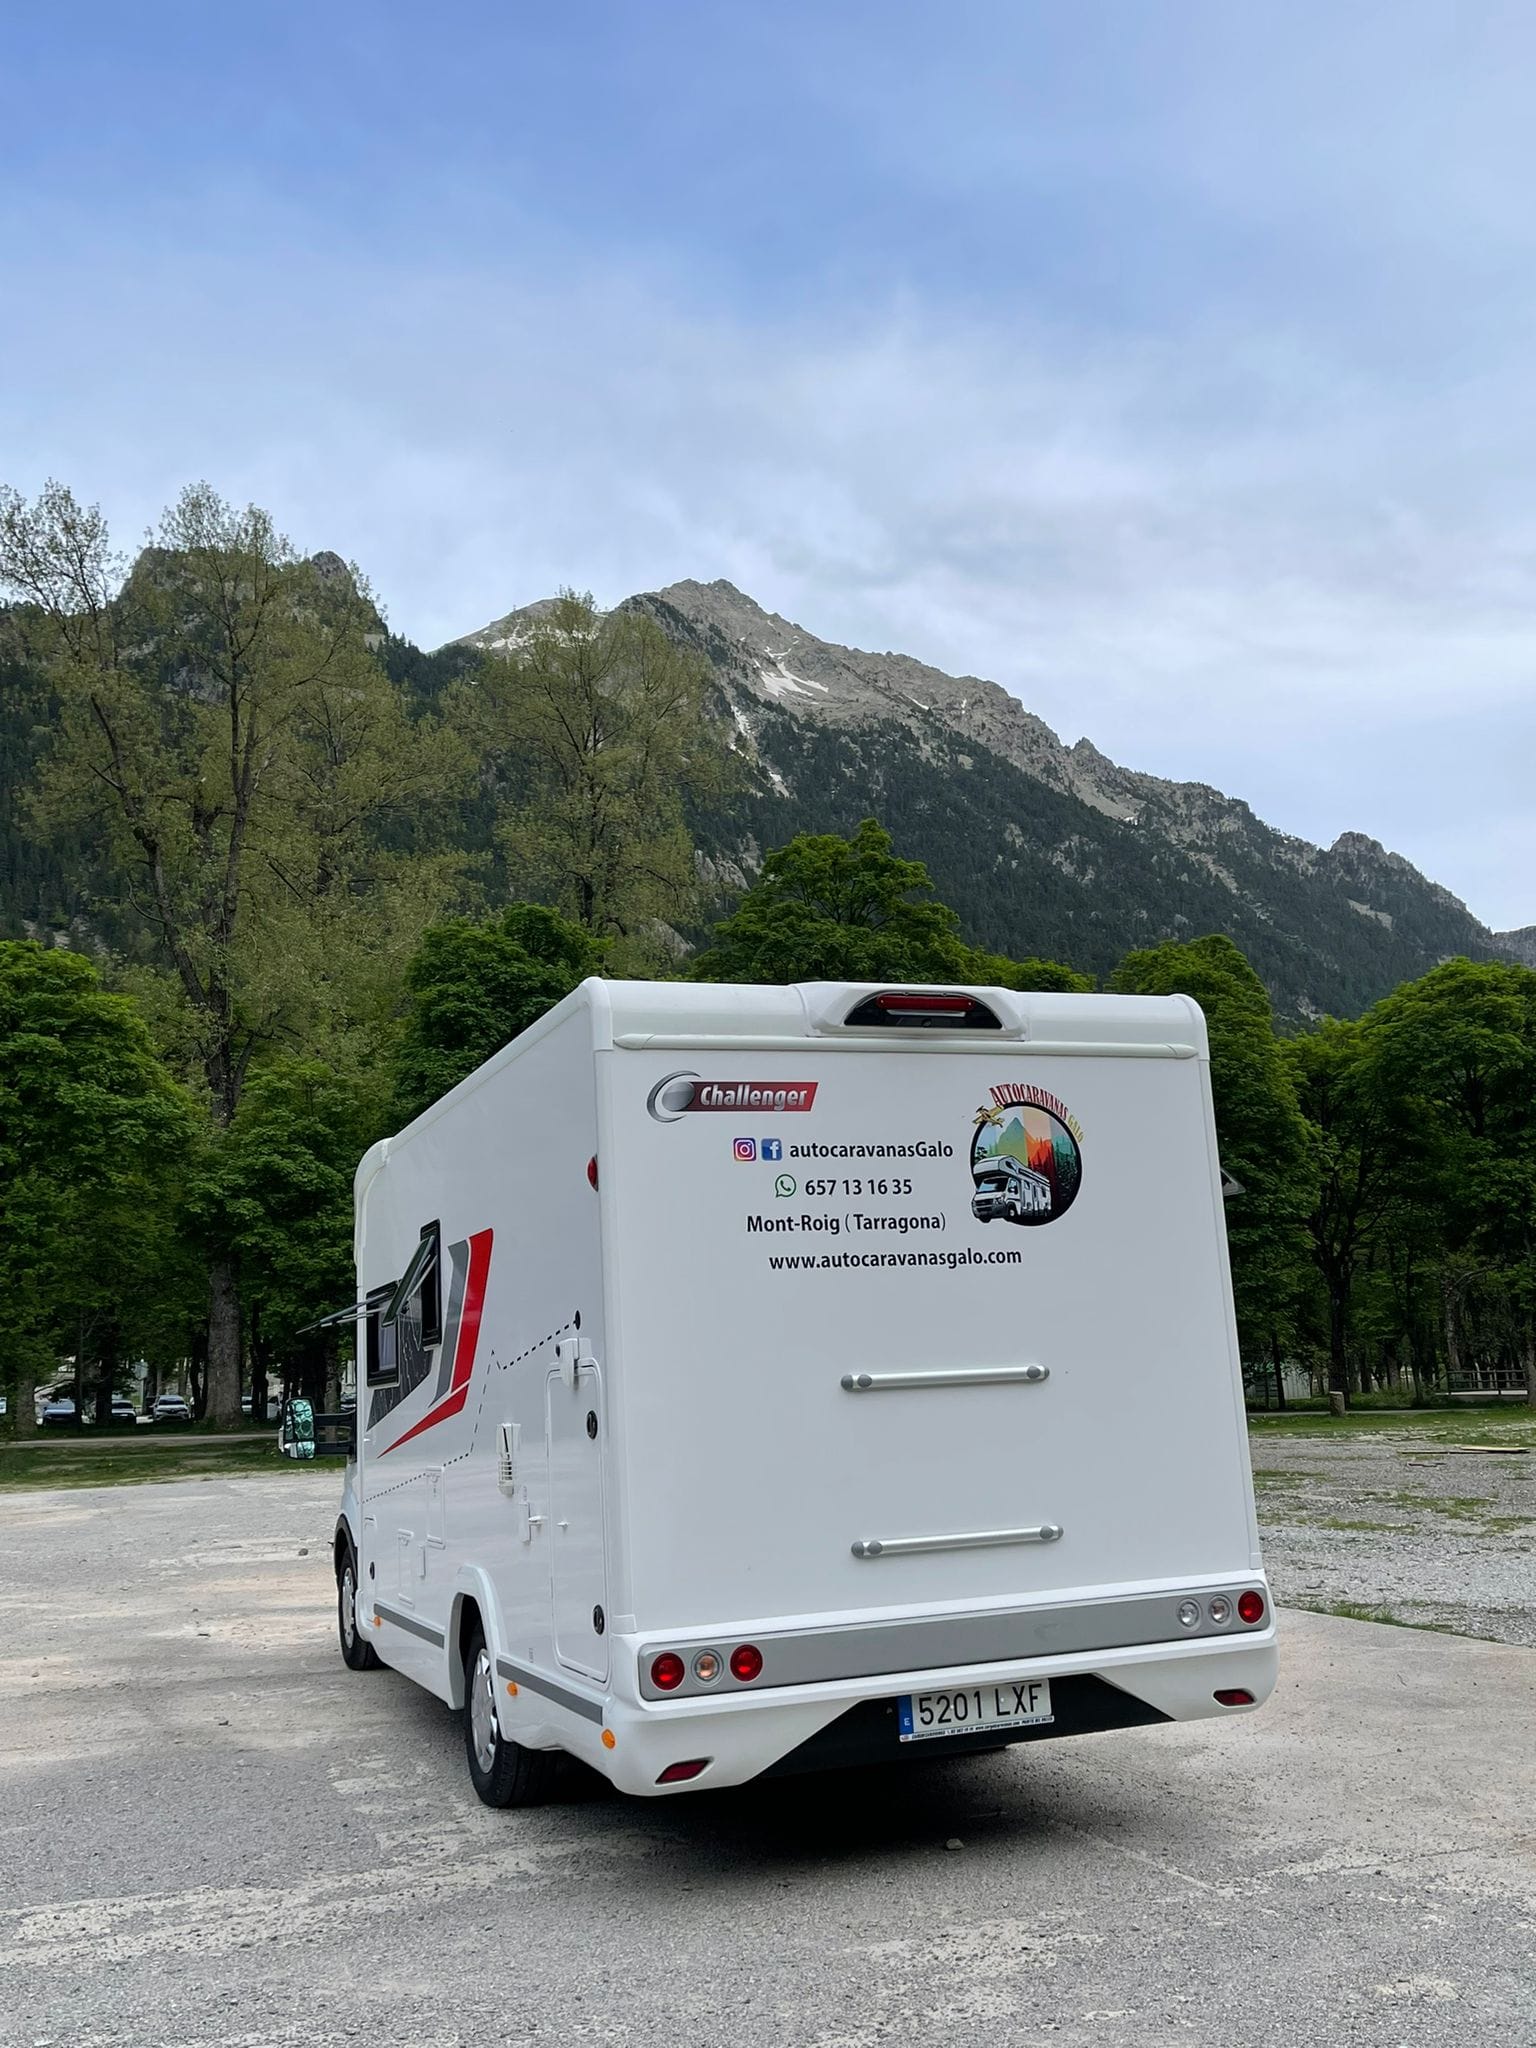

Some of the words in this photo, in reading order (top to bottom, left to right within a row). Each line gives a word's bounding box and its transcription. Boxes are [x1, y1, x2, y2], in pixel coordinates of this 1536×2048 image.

[701, 1084, 808, 1111] Challenger
[989, 1083, 1069, 1120] AUTOCARAVANAS
[1067, 1114, 1085, 1144] GALO
[789, 1141, 954, 1158] autocaravanasGalo
[805, 1179, 837, 1196] 657
[842, 1179, 863, 1195] 13
[867, 1178, 888, 1195] 16
[892, 1178, 913, 1195] 35
[746, 1213, 840, 1235] Mont-Roig
[769, 1248, 1023, 1269] www.autocaravanasgalo.com
[918, 1690, 983, 1725] 5201
[995, 1683, 1042, 1717] LXF
[904, 1717, 911, 1727] E
